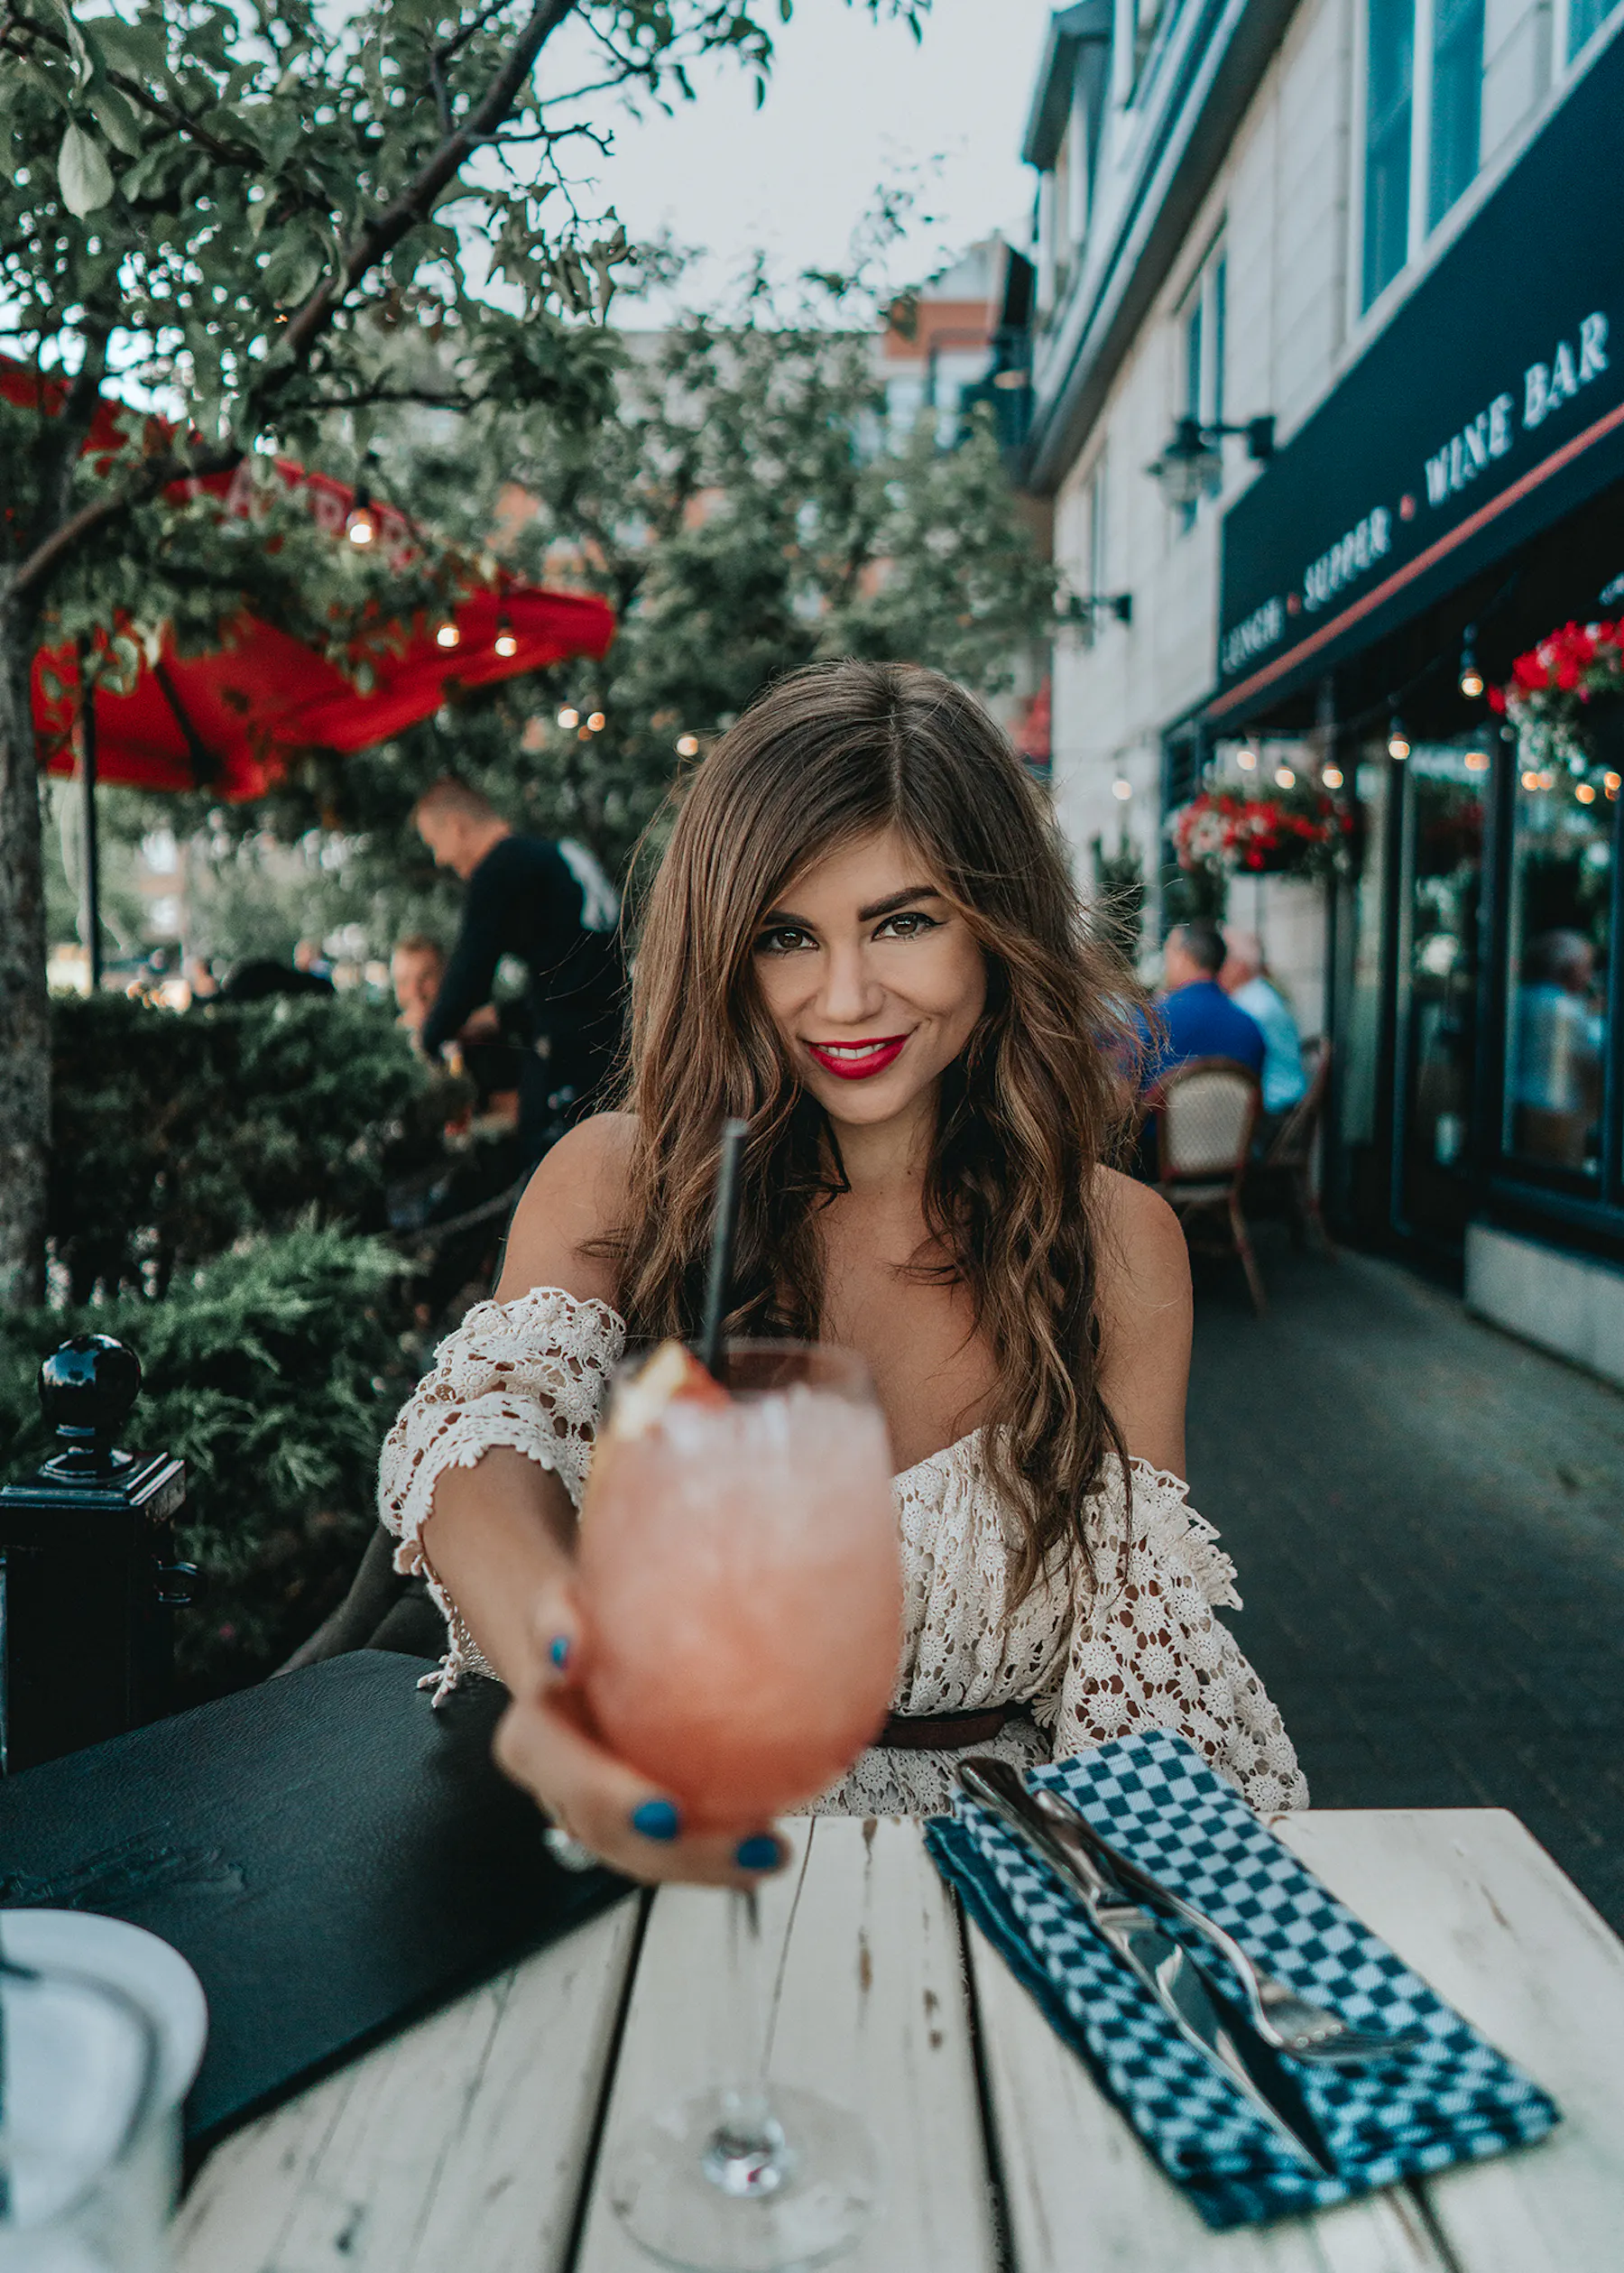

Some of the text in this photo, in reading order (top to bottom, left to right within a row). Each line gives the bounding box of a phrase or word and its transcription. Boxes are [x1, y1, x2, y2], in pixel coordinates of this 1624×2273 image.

[1304, 505, 1391, 612] SUPPER
[1426, 393, 1512, 506] WINE
[1522, 311, 1609, 429] BAR
